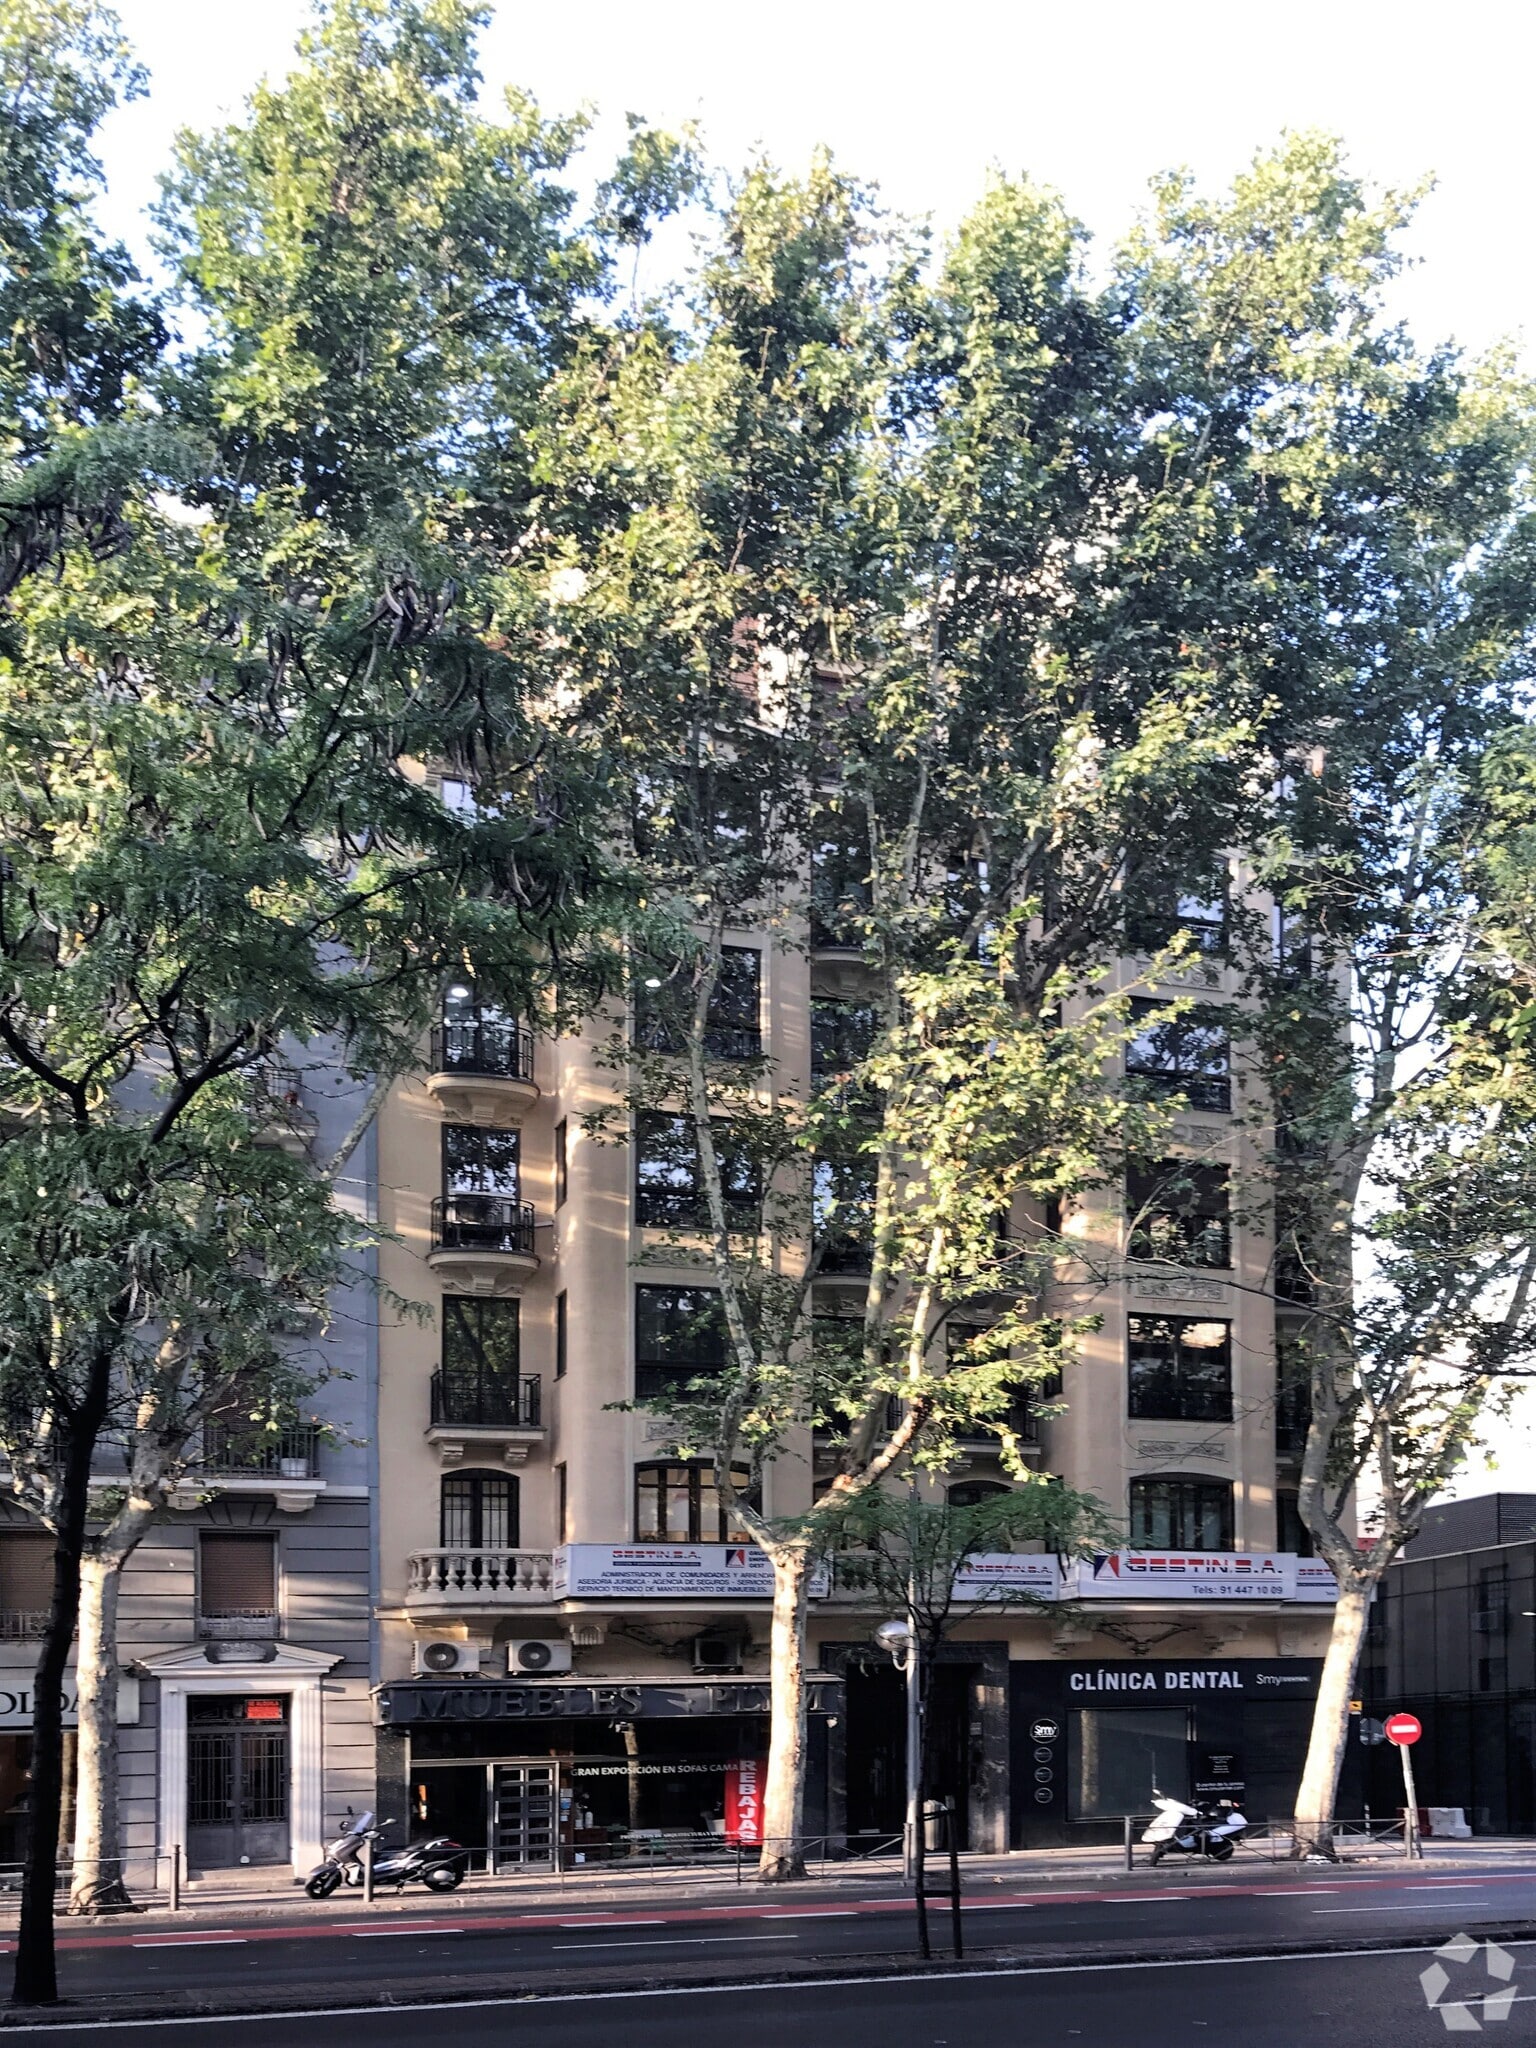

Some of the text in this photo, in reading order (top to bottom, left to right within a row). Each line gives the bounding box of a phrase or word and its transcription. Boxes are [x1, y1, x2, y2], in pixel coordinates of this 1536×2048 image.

[1220, 1586, 1231, 1594] 91
[1234, 1586, 1253, 1594] 447
[1257, 1586, 1269, 1594] 10
[1270, 1586, 1283, 1594] 09
[1070, 1669, 1157, 1691] CLÍNICA
[1165, 1671, 1244, 1689] DENTAL
[411, 1686, 642, 1718] MUEBLES
[570, 1767, 600, 1776] GRAN
[662, 1765, 676, 1774] EN
[677, 1764, 708, 1773] SOFAS
[738, 1760, 758, 1842] REBAJAS
